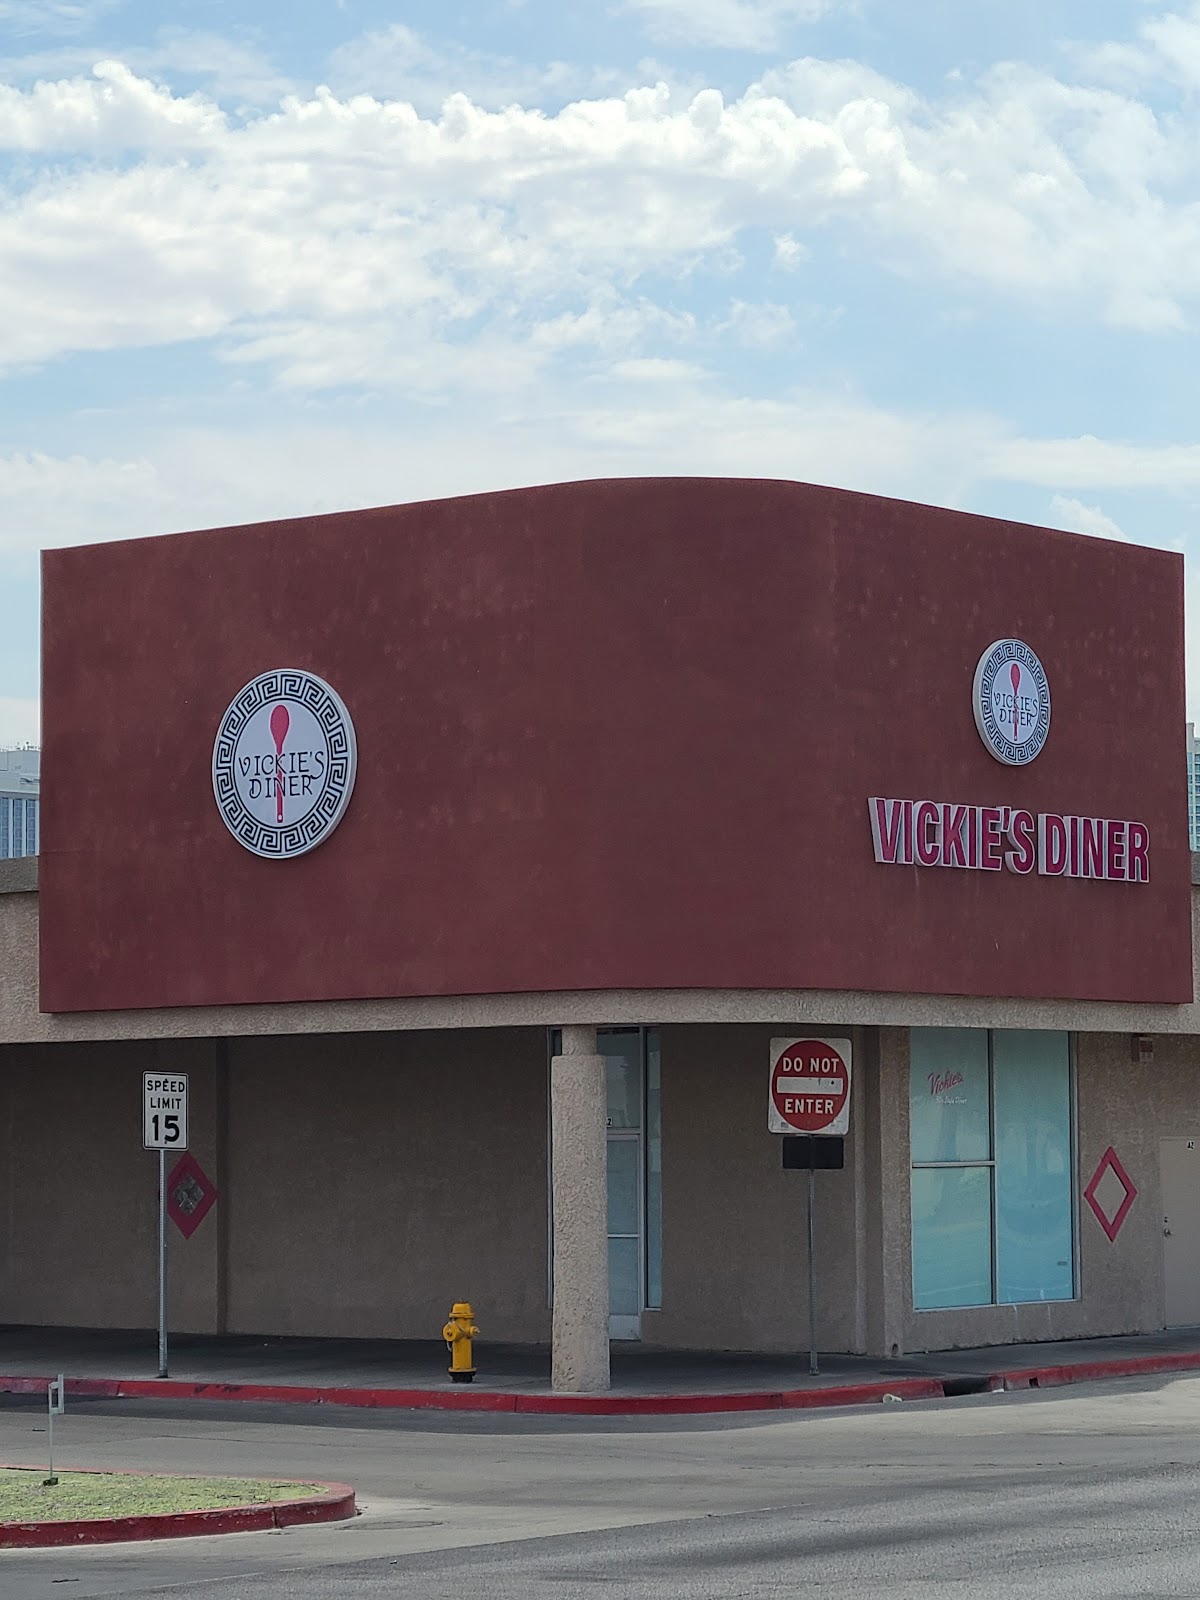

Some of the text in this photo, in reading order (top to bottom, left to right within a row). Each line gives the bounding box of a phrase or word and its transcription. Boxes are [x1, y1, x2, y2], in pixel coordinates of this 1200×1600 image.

[993, 692, 1038, 718] VICKIE'S
[999, 708, 1033, 728] DINER
[238, 751, 325, 780] VICKIE'S
[249, 774, 313, 799] DINER
[868, 797, 1150, 883] VICKIE'S DINER
[782, 1057, 840, 1073] DO NOT
[146, 1079, 185, 1093] SPEED
[150, 1097, 182, 1110] LIMIT
[784, 1098, 834, 1115] ENTER
[152, 1114, 180, 1143] 15
